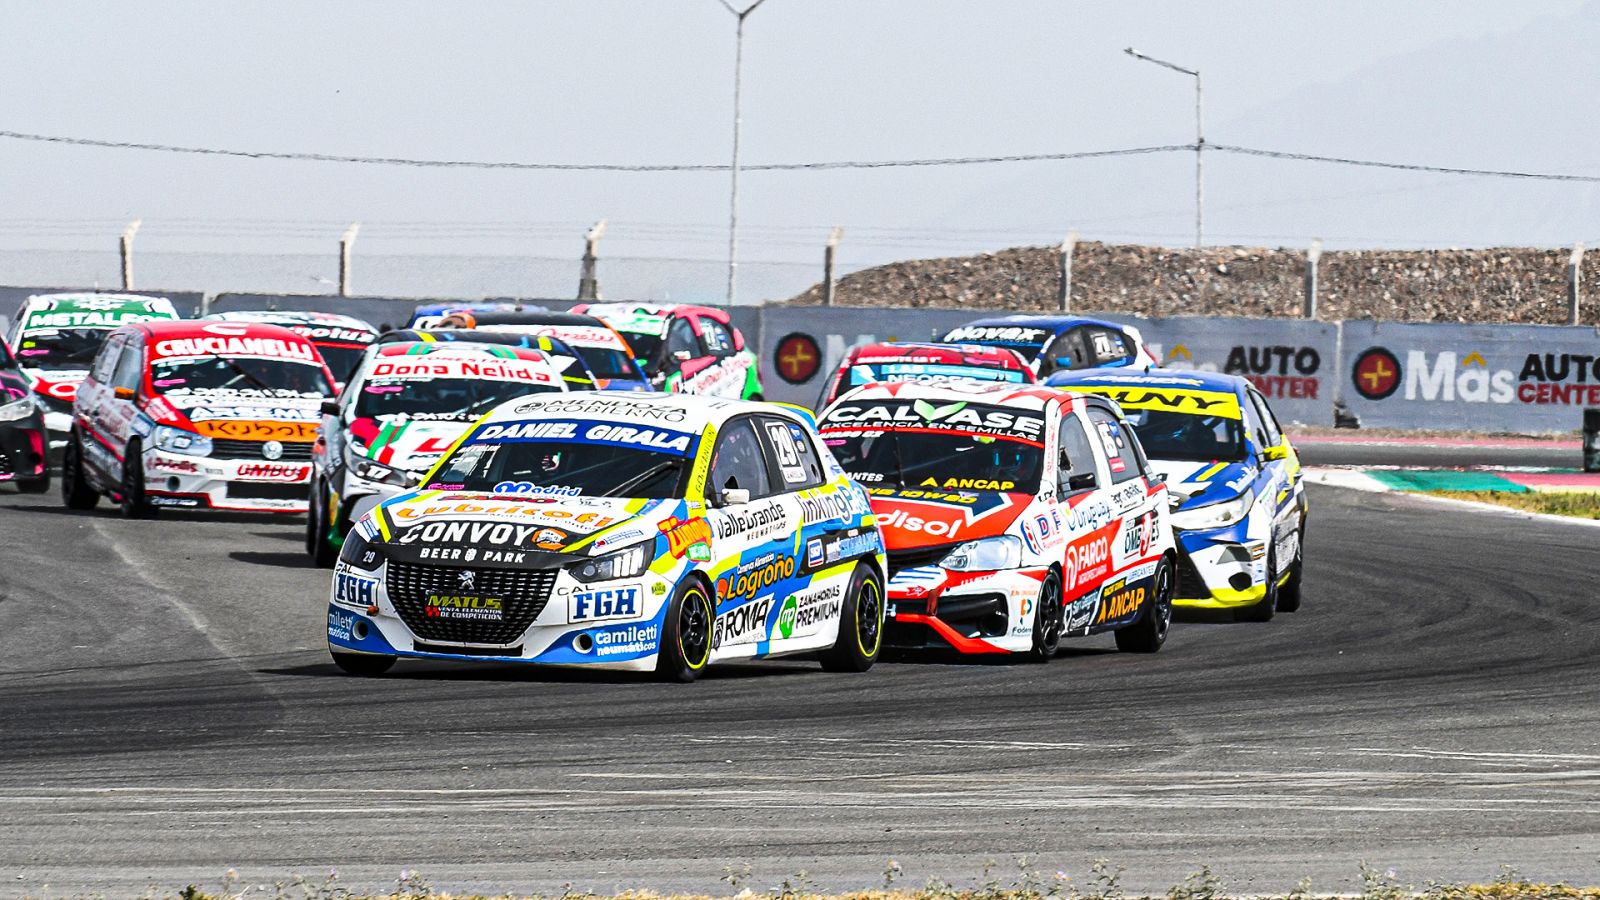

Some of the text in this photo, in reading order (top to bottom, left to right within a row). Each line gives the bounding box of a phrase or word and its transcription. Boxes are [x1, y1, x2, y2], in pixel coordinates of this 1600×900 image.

[156, 338, 313, 361] CRUCIANELLI
[1224, 346, 1321, 376] AUTO
[461, 363, 550, 382] Nelida
[1247, 375, 1319, 400] NTER
[543, 406, 685, 422] GOBIERNO
[549, 399, 687, 415] MENDOZA
[476, 422, 691, 453] DANIEL GIRALA
[821, 421, 925, 431] EXCELENCIA
[957, 425, 1038, 443] SEMILLAS
[771, 426, 798, 465] 29
[493, 481, 581, 499] Madrid
[943, 478, 1015, 491] ANCAP
[399, 523, 534, 546] CONVOY
[363, 551, 375, 563] 29
[420, 548, 525, 564] BEER PARK
[1078, 536, 1108, 571] FARCO
[727, 555, 795, 601] Logroño
[428, 594, 502, 609] MATUS
[557, 584, 595, 597] CAL
[438, 607, 502, 616] VENTA ELEMENTOS
[573, 588, 637, 620] FGH
[796, 600, 839, 629] PREMIUM
[1107, 587, 1145, 620] ANCAP
[724, 599, 770, 642] ROMA
[595, 624, 657, 645] camiletti
